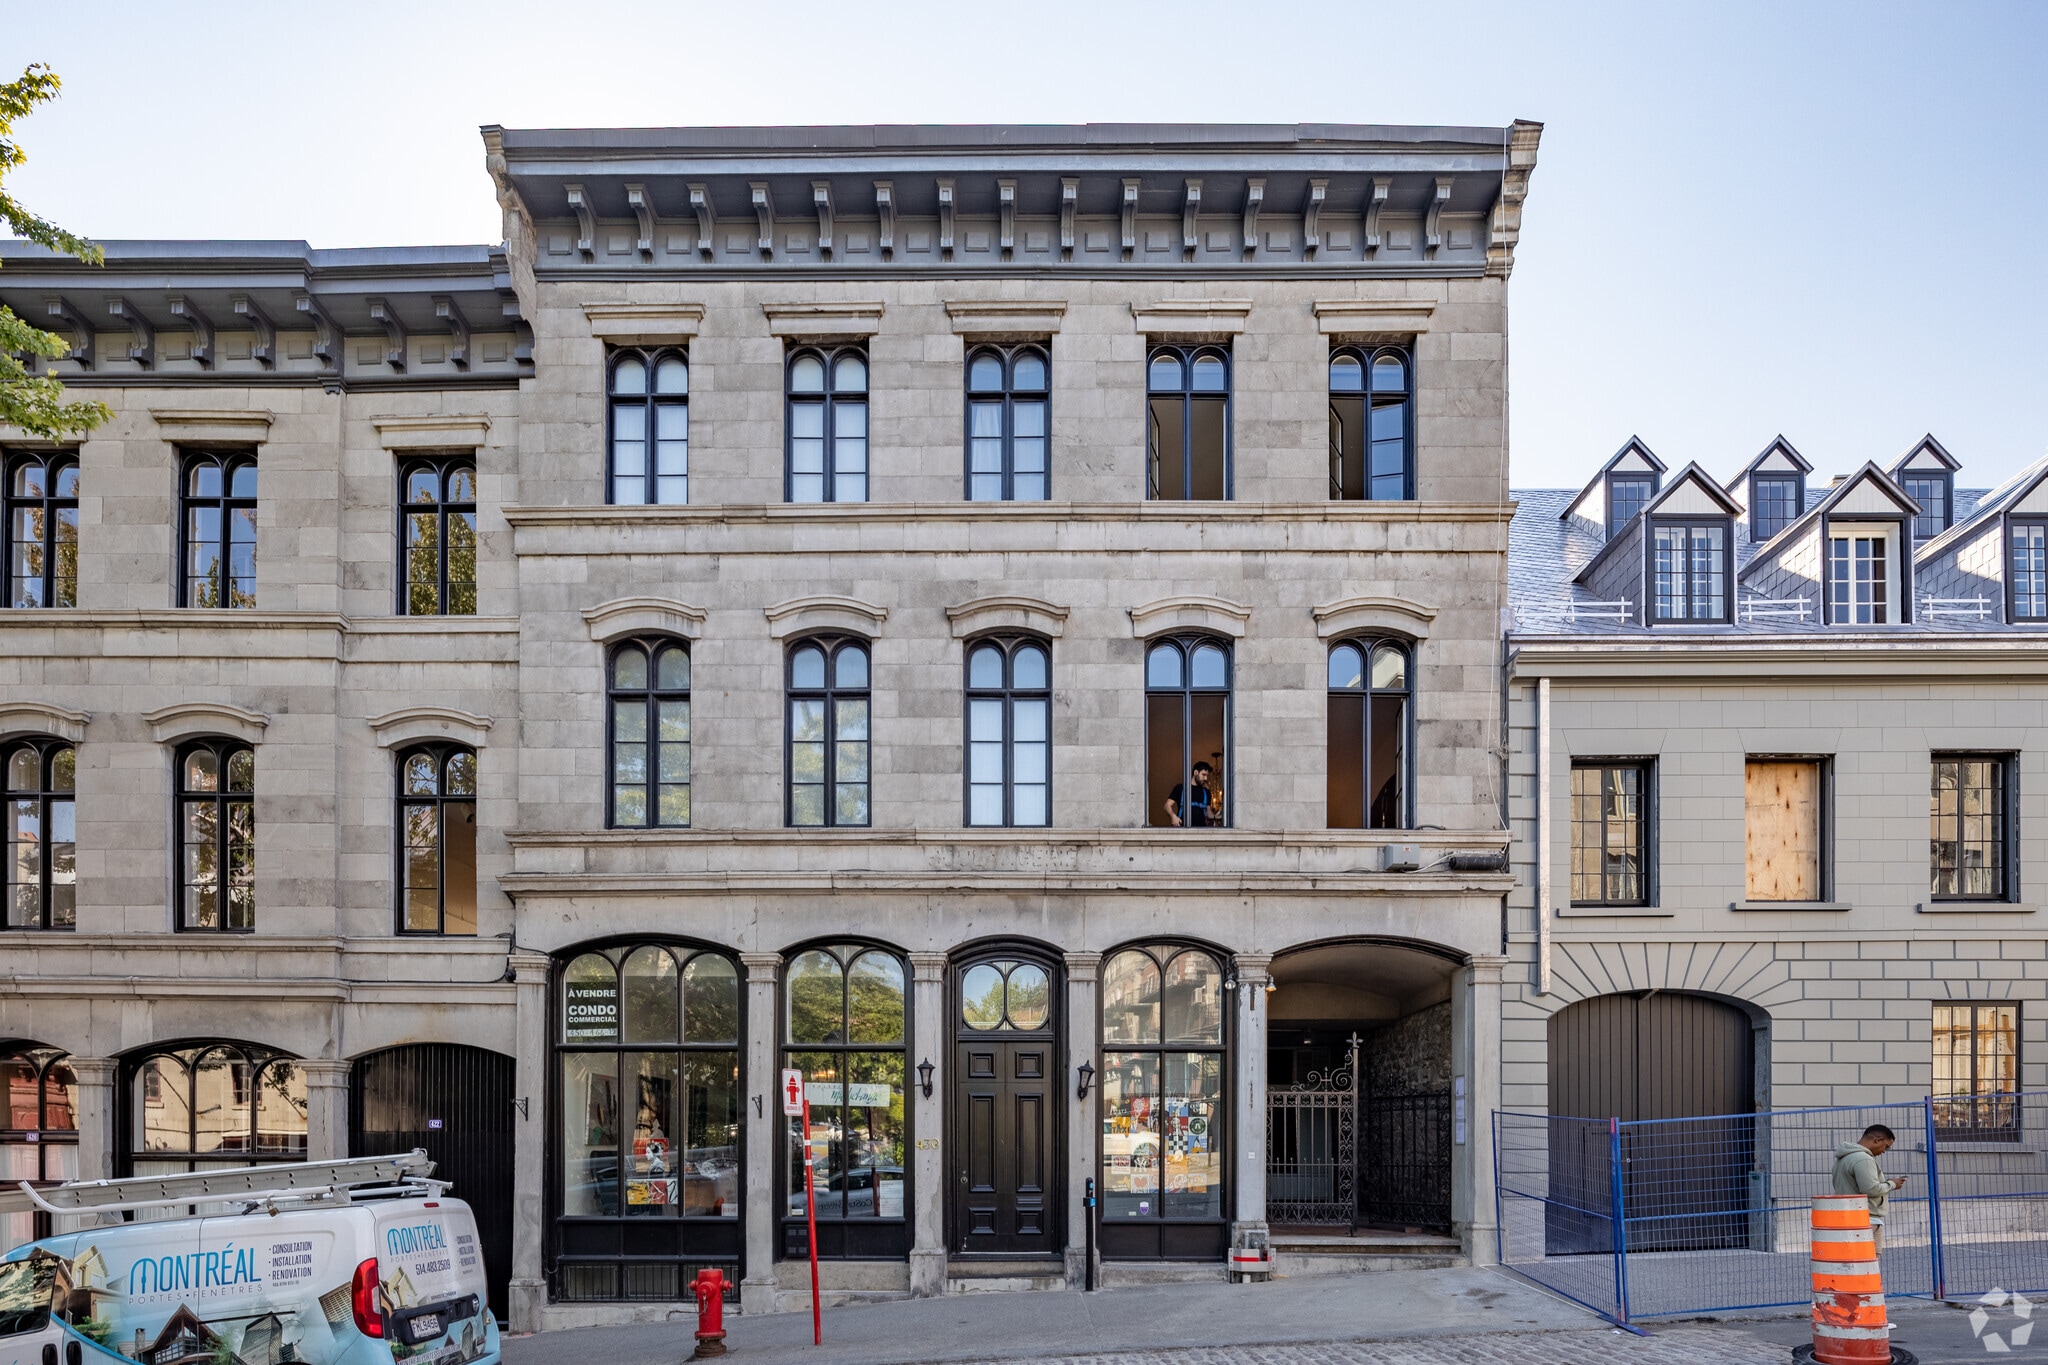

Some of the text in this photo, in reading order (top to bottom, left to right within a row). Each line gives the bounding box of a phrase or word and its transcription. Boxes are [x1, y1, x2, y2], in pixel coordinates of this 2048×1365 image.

[576, 989, 616, 998] VENDRE
[568, 1004, 617, 1016] CONDO
[916, 1138, 940, 1150] 430
[387, 1220, 447, 1256] MONTRÉAL
[272, 1240, 312, 1254] CONSULTATION
[272, 1253, 312, 1267] INSTALLATION
[415, 1258, 451, 1276] 514.483.2509
[130, 1242, 261, 1295] MONTRÉAL
[272, 1266, 312, 1280] RENOVATION
[128, 1293, 182, 1305] PORTES
